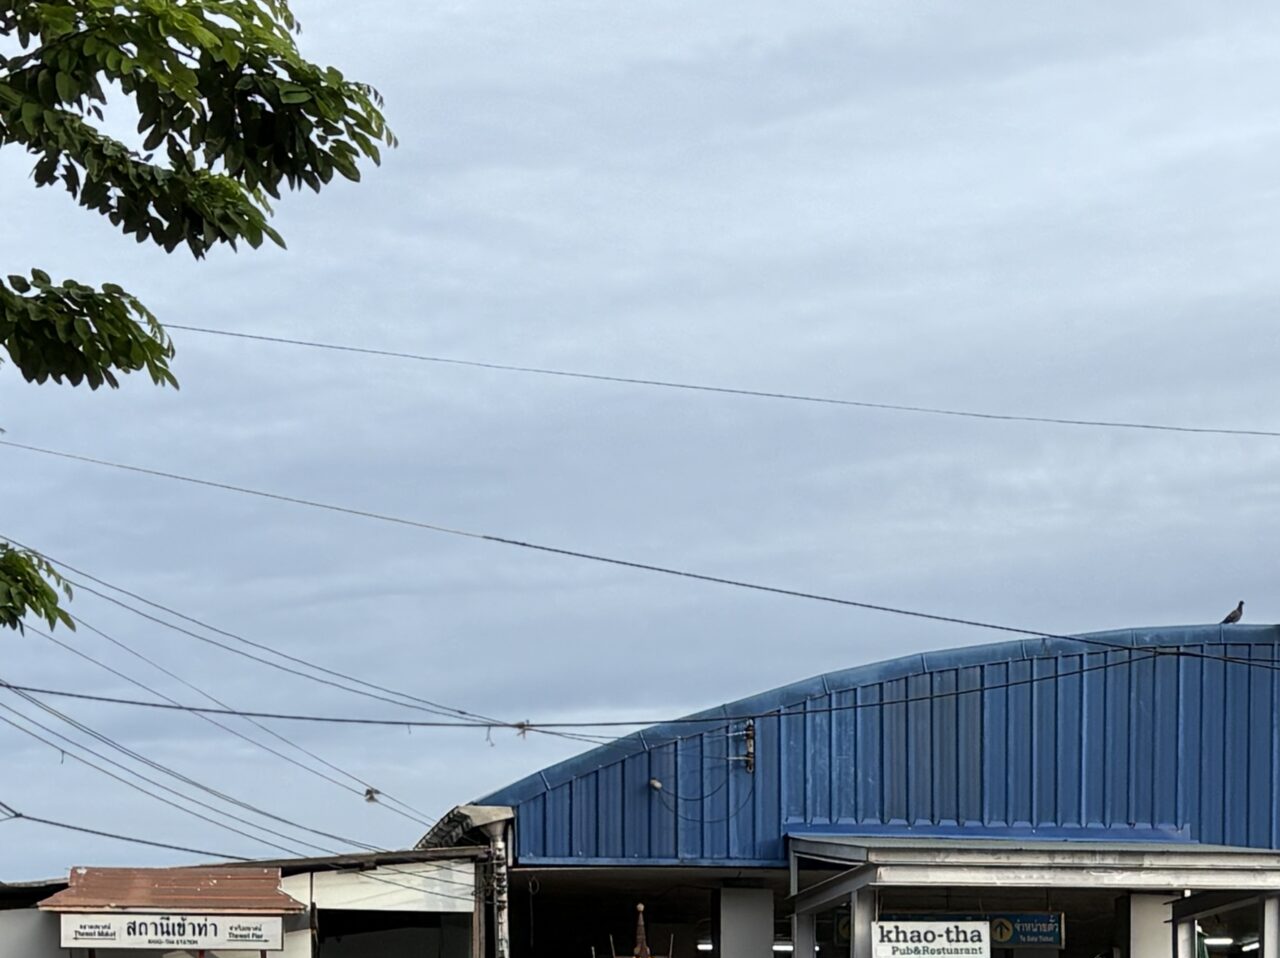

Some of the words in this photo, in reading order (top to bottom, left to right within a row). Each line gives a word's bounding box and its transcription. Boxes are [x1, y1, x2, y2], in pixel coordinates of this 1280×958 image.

[126, 916, 218, 937] สถานีเข้าท่า
[878, 924, 983, 944] khao-tha
